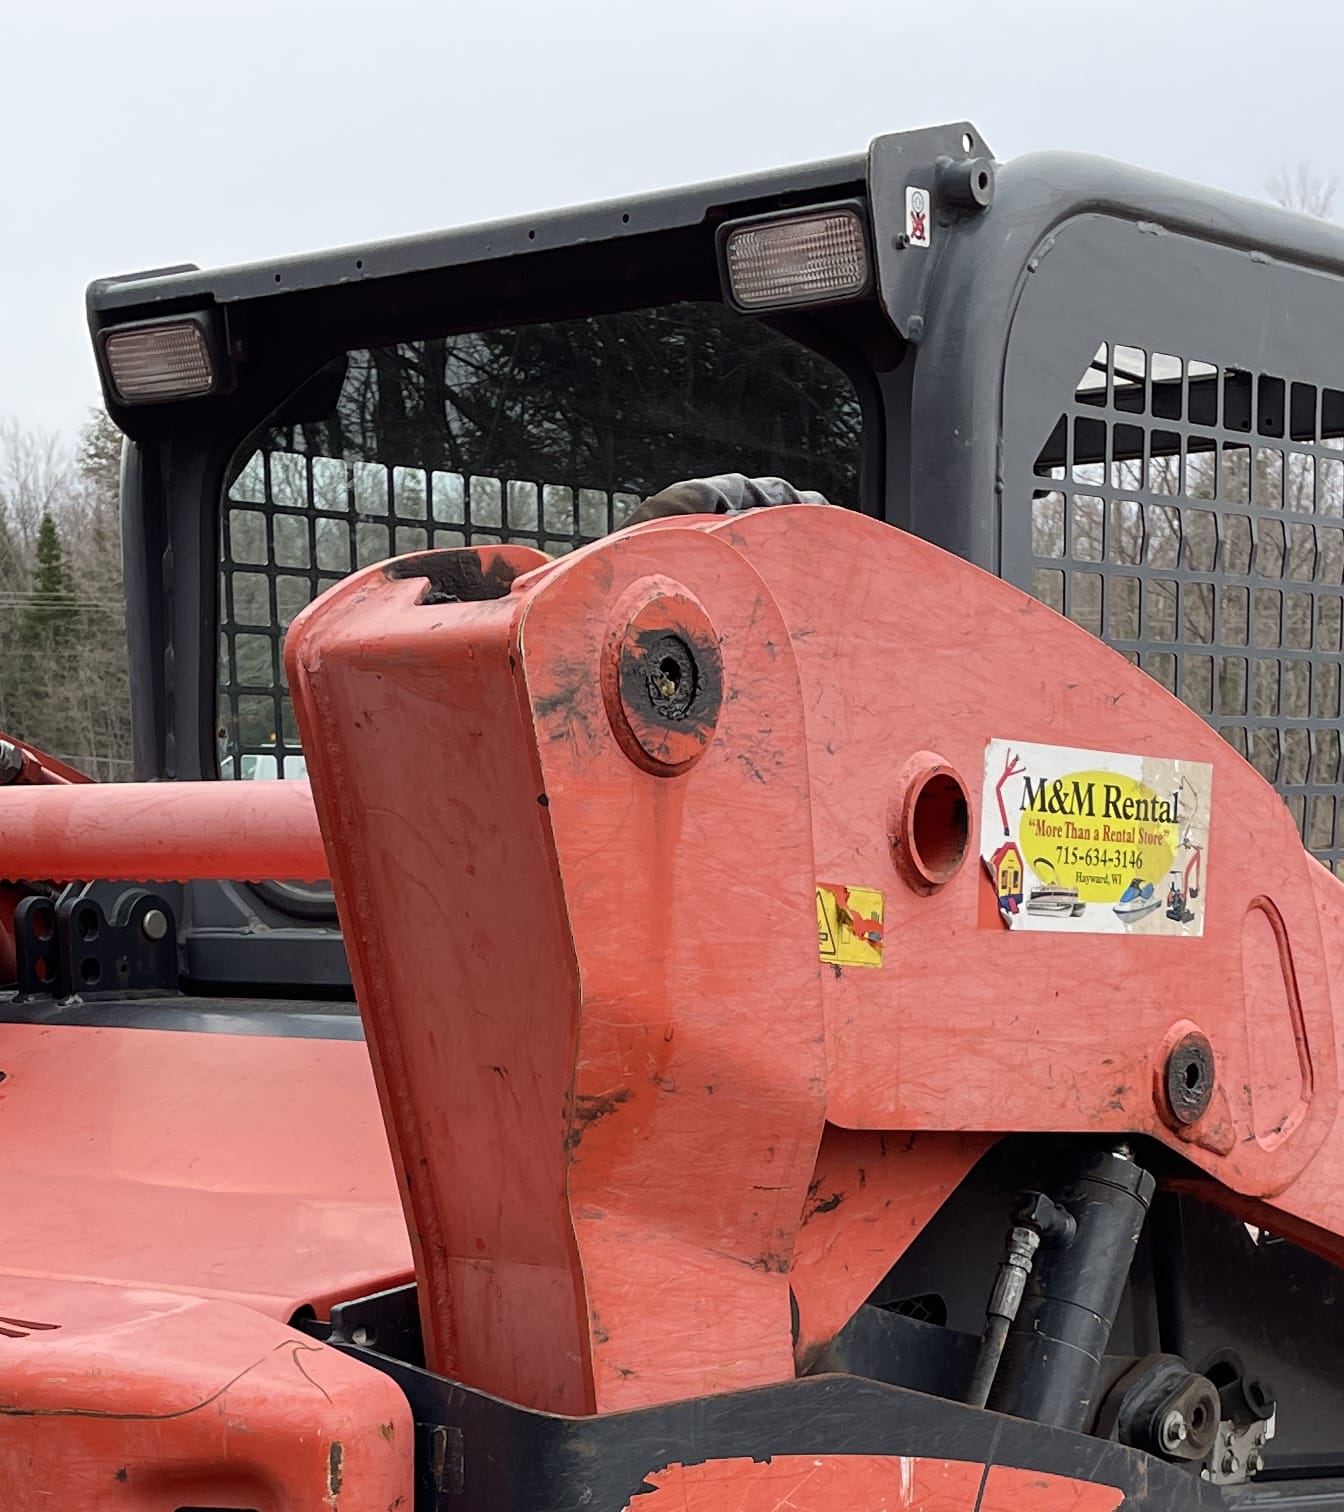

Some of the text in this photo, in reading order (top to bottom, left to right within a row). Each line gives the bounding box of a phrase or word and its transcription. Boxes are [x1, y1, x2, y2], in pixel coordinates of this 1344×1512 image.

[1019, 775, 1180, 825] M&M Rental
[1064, 821, 1091, 841] Than
[1093, 829, 1100, 841] a
[1102, 824, 1136, 844] Rental
[1056, 846, 1143, 870] 715-634-3146
[1075, 871, 1122, 886] Hayward, WI
